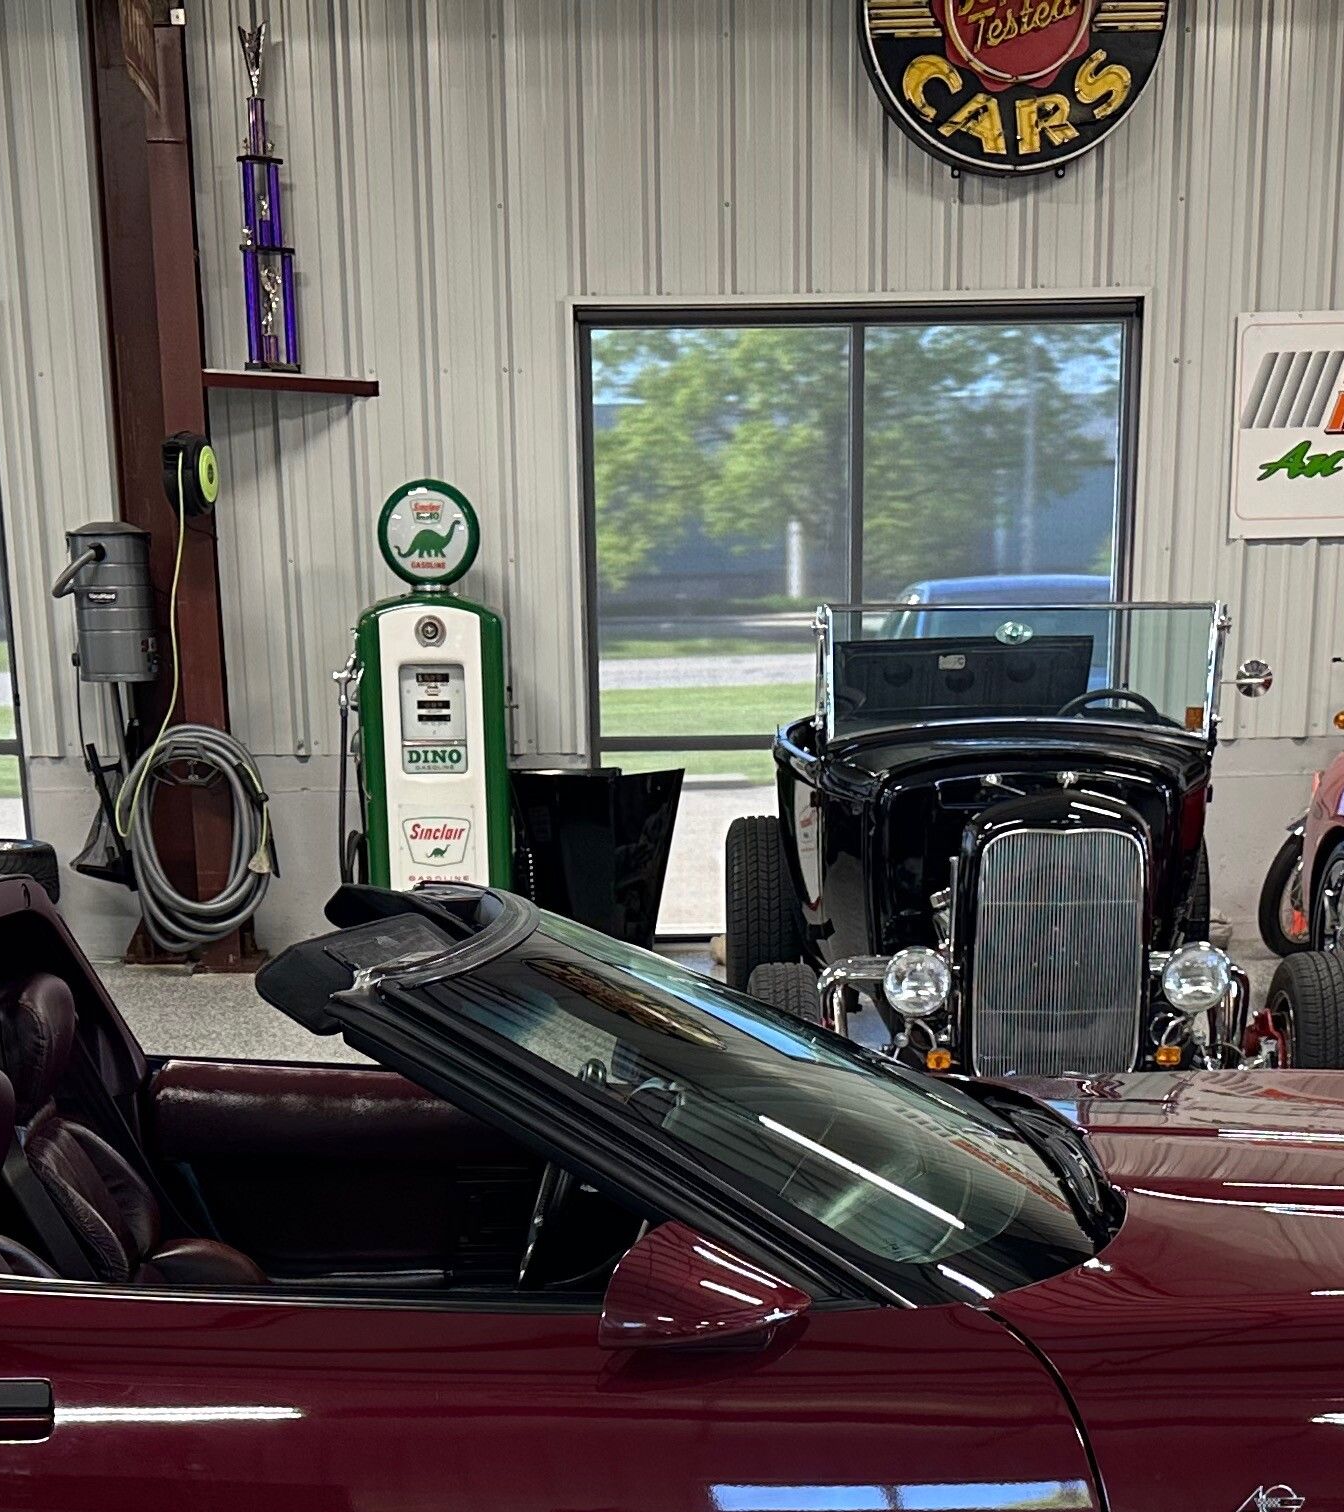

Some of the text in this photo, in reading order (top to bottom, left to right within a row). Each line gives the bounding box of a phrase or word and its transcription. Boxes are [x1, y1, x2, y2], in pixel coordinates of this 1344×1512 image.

[902, 48, 1132, 155] CARS
[407, 748, 462, 764] DINO
[409, 823, 466, 841] Sinclair
